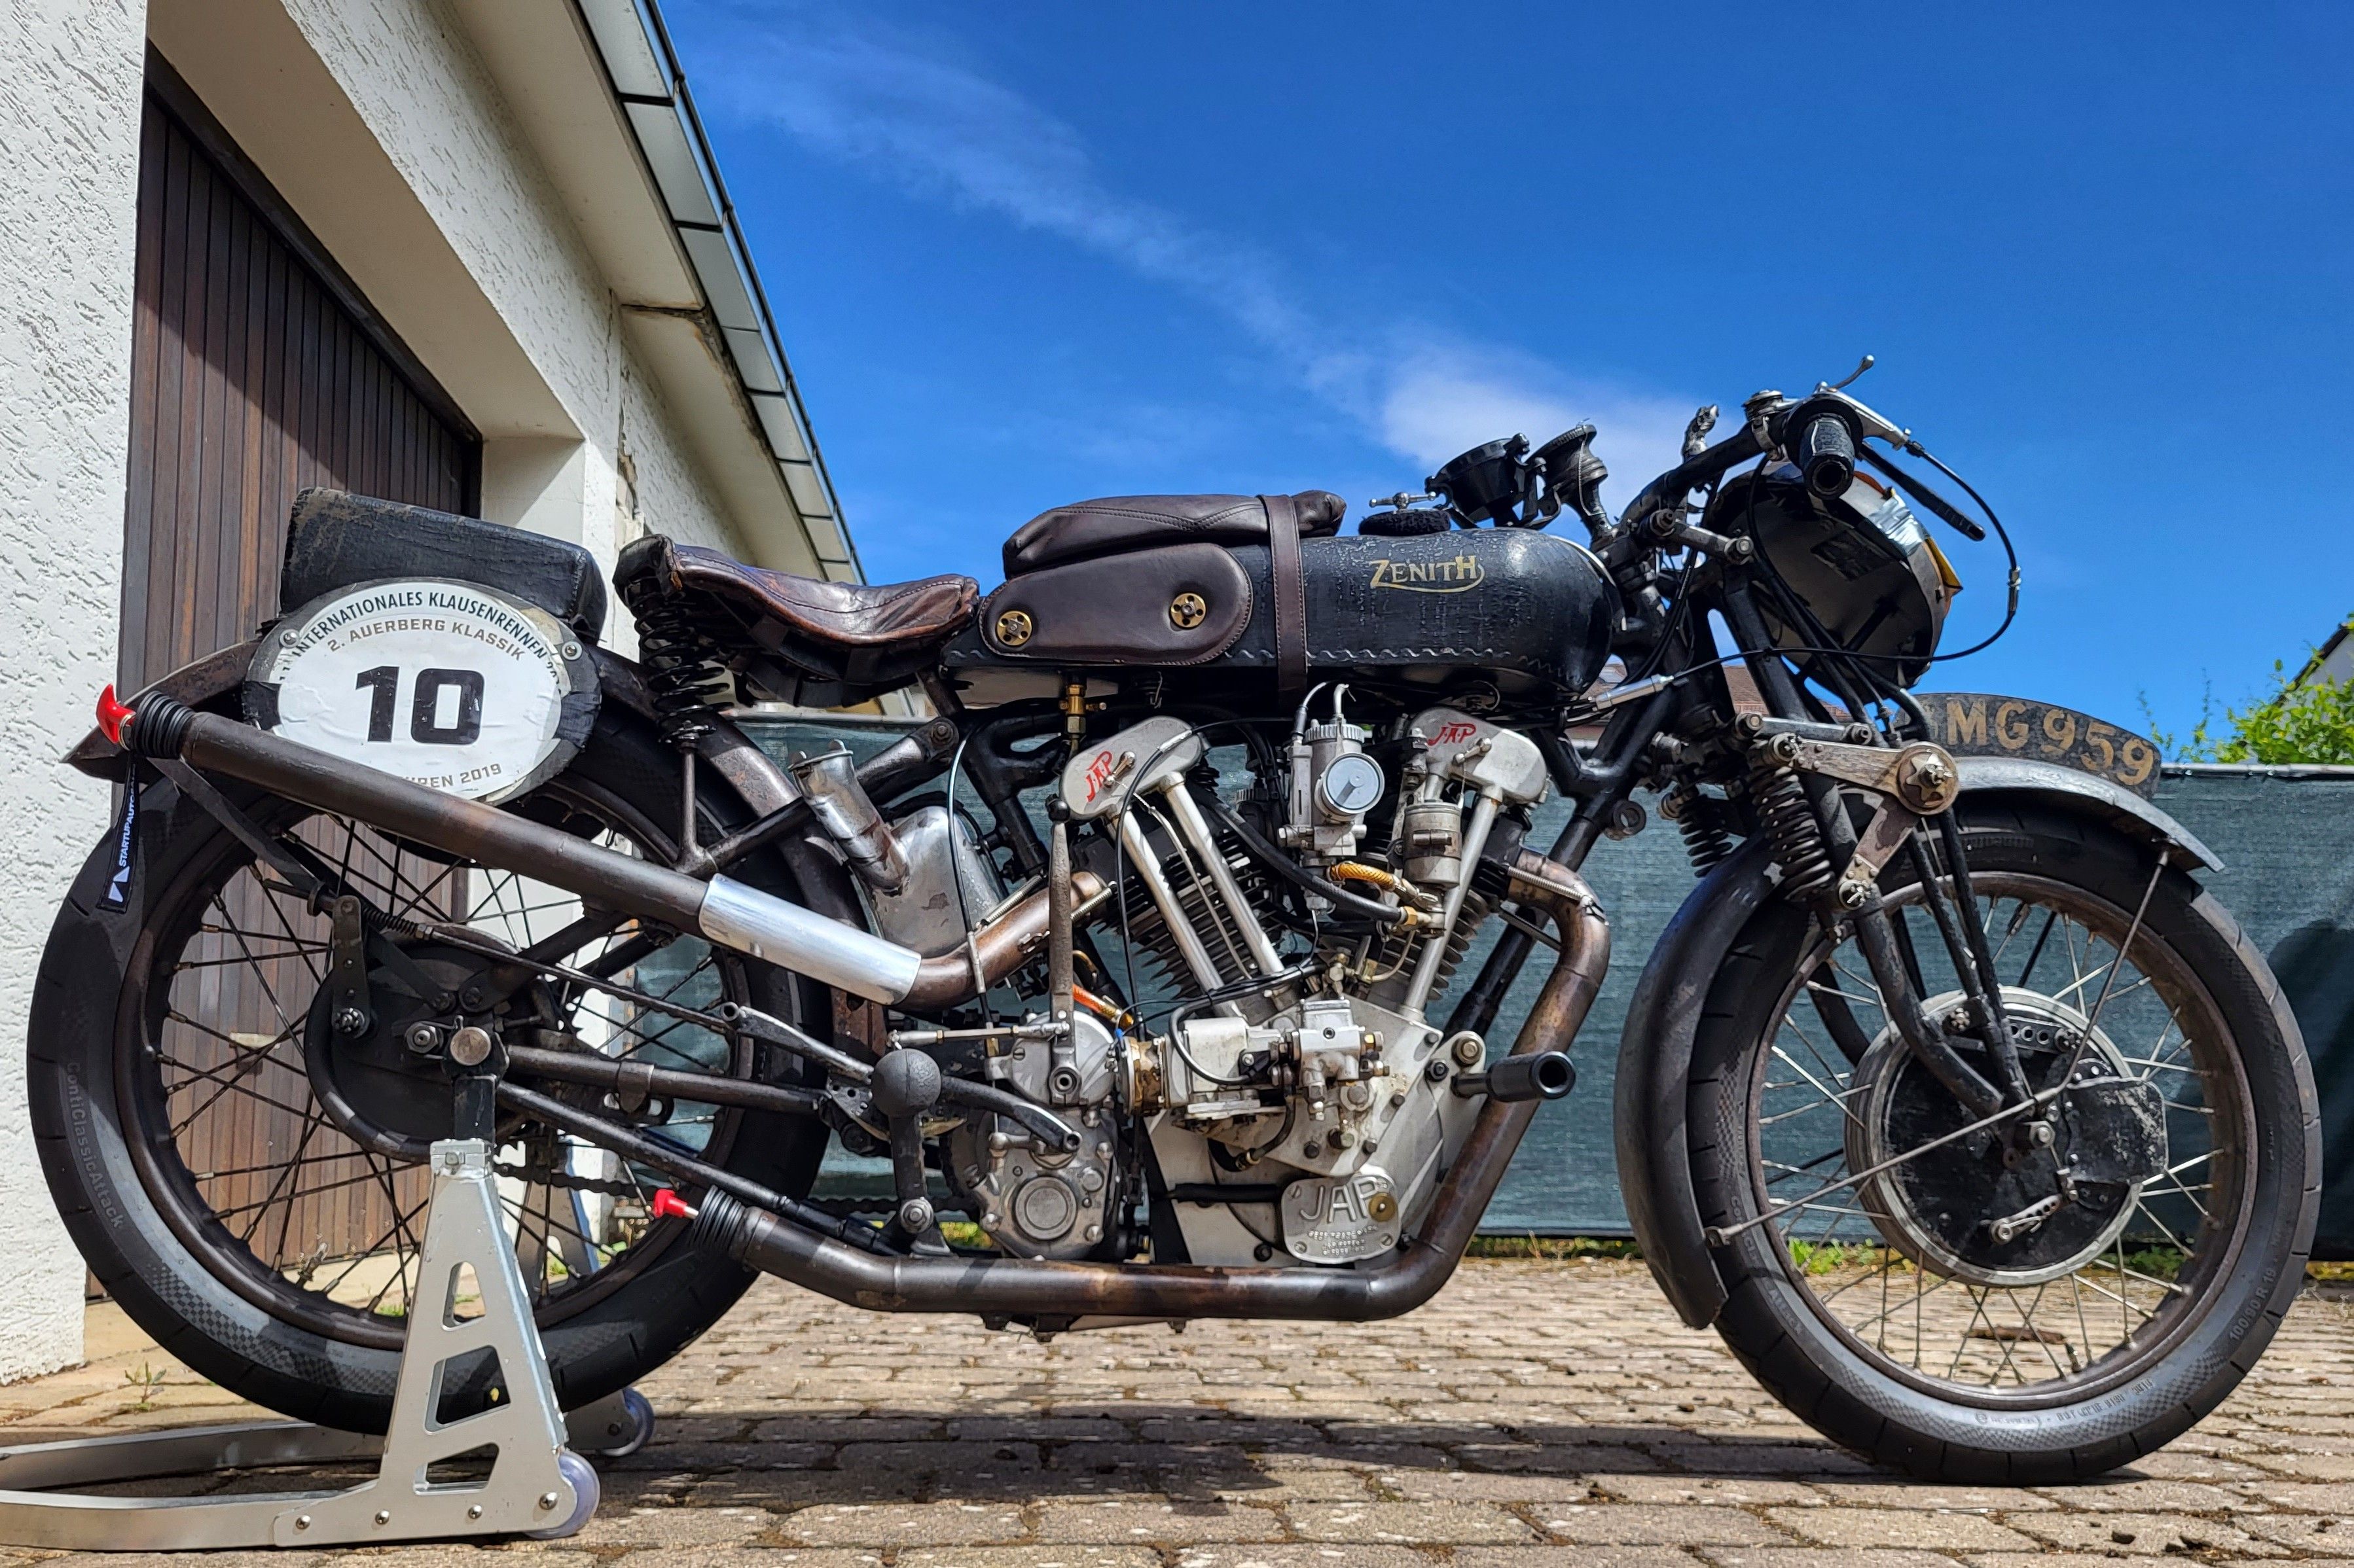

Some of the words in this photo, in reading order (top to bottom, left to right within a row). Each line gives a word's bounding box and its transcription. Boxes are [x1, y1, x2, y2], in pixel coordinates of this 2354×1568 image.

[1369, 555, 1485, 593] ZENITH
[291, 591, 423, 657] INTERNATIONALES
[429, 593, 547, 659] KLAUSENRENNEN
[327, 639, 345, 652] 2.
[349, 618, 446, 643] AUERBERG
[452, 622, 525, 661] KLASSIK
[354, 665, 486, 745] 10
[460, 763, 502, 784] 2019
[67, 1061, 124, 1228] ContiClassicAttack
[1299, 1175, 1379, 1223] JAP
